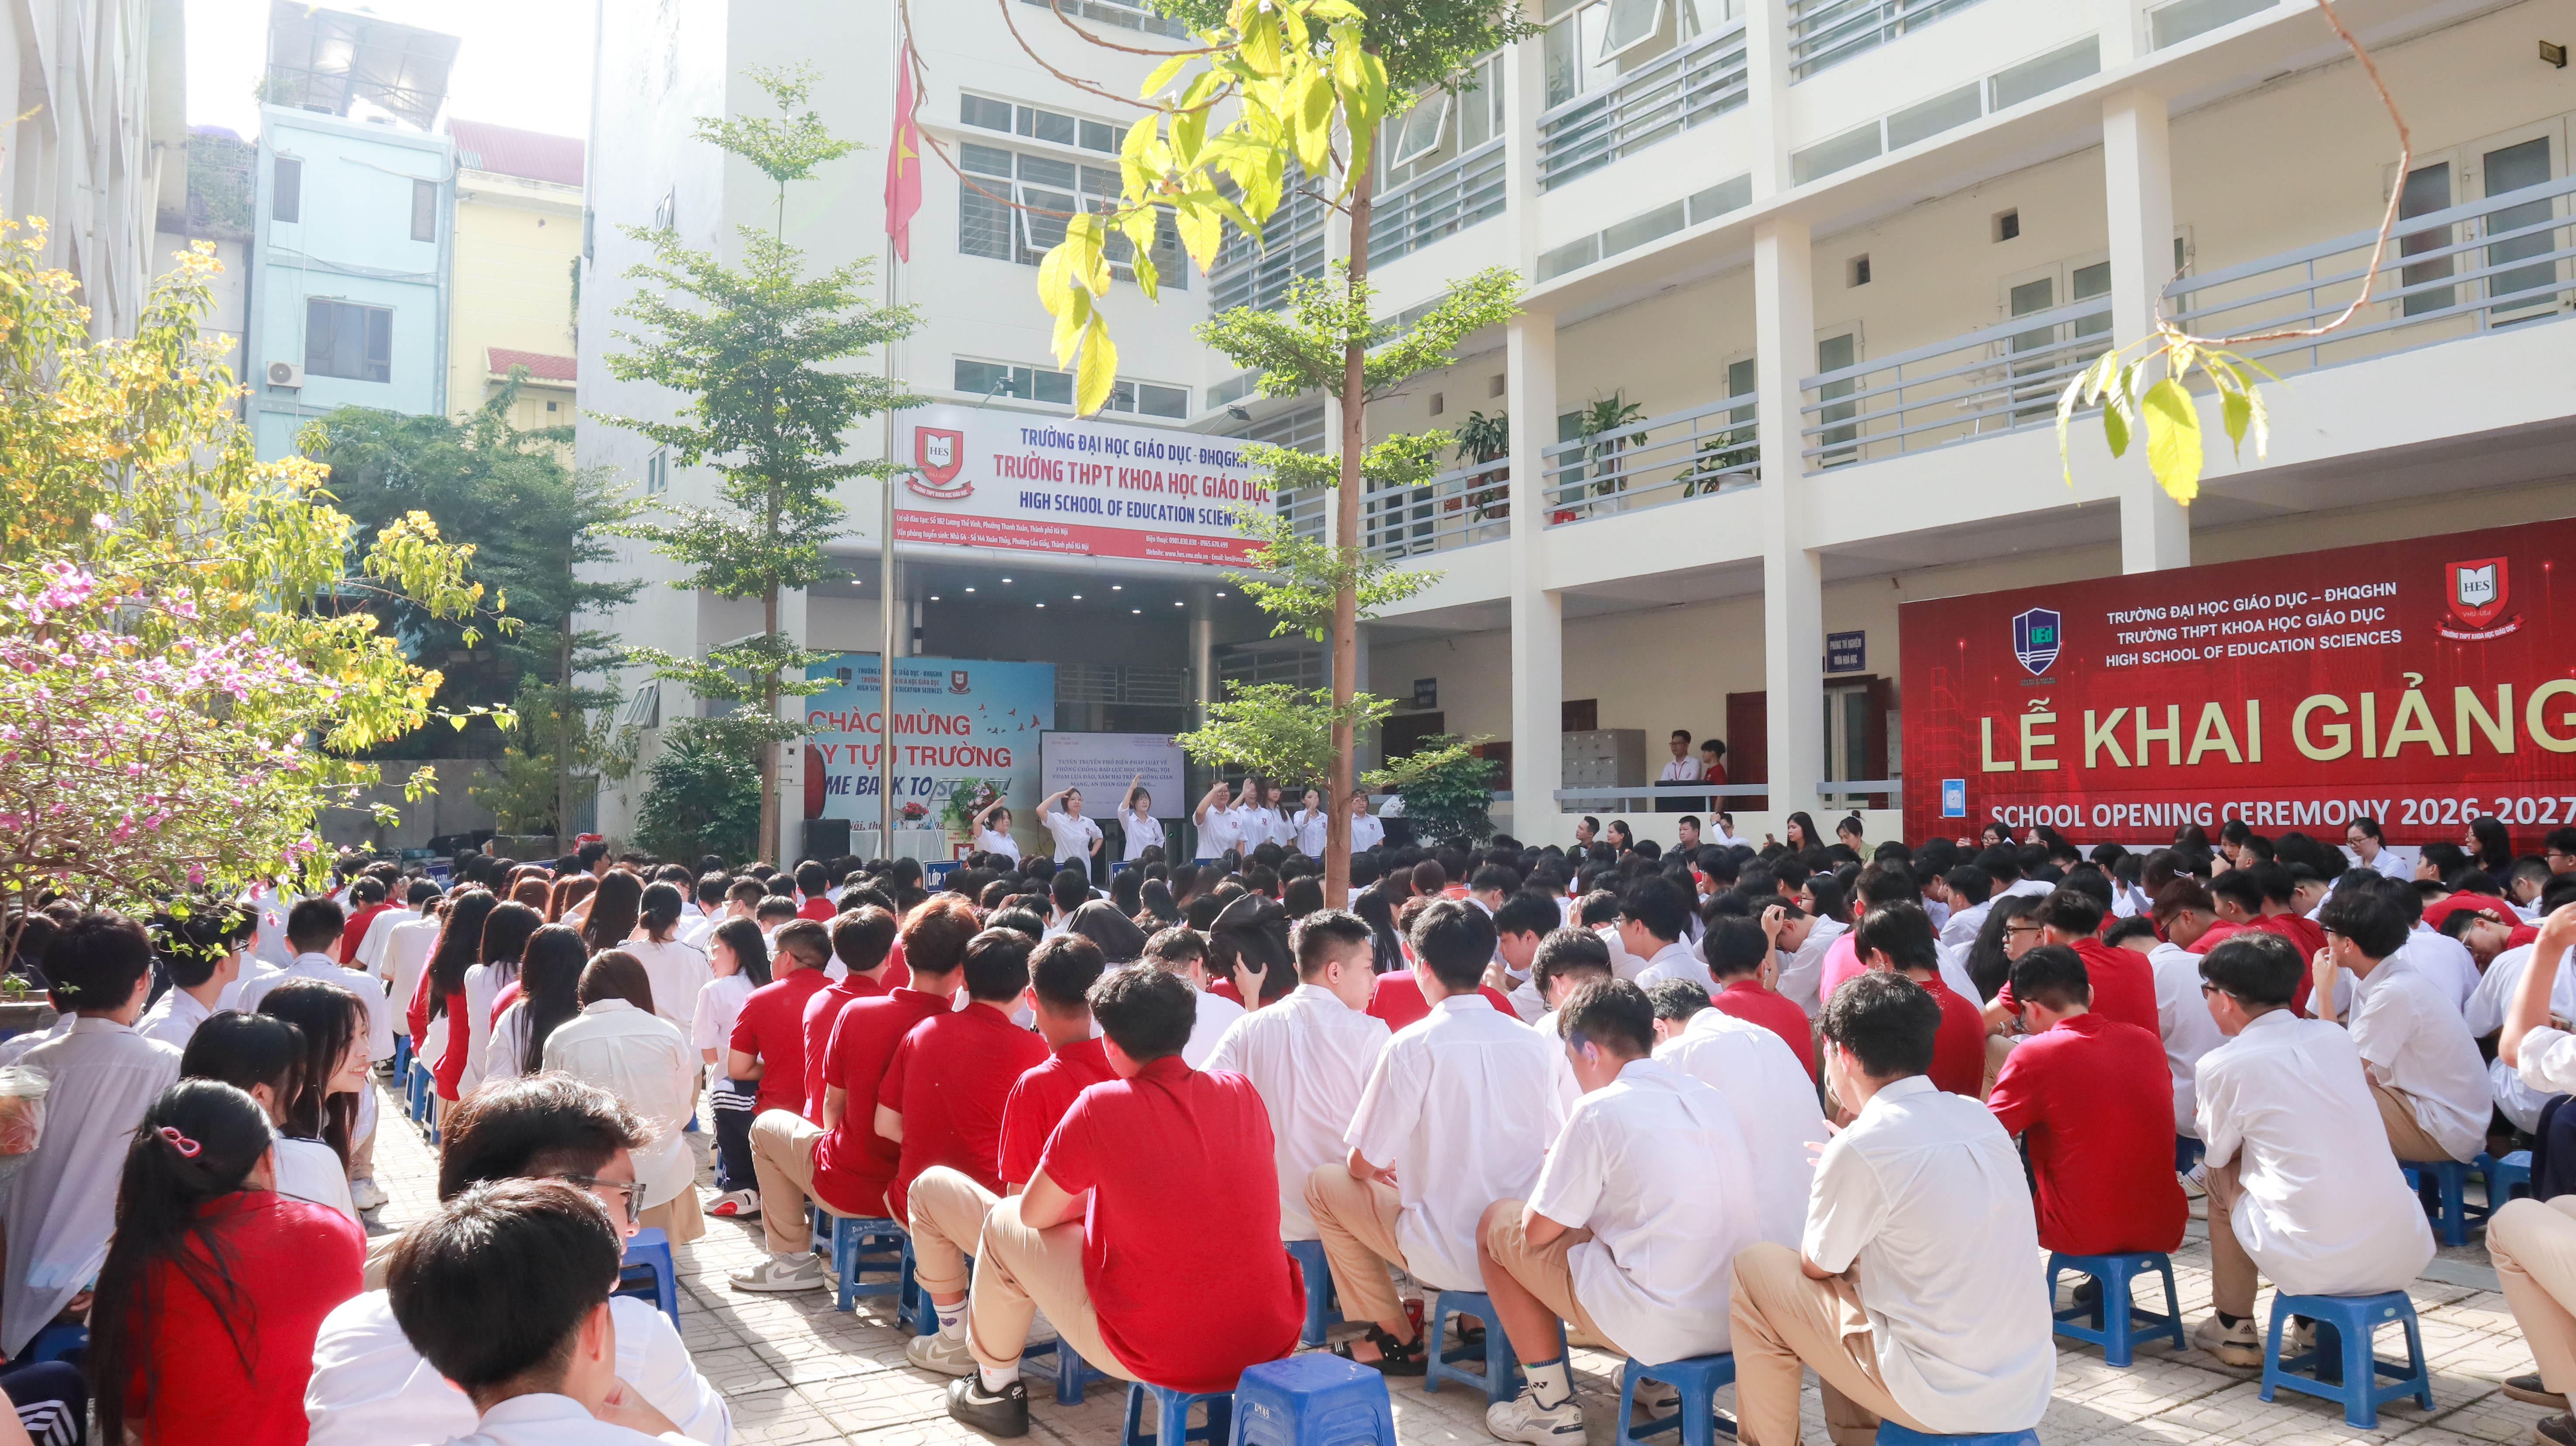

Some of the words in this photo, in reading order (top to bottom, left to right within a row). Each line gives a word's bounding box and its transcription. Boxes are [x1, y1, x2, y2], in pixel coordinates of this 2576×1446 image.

[929, 447, 949, 456] HES
[1021, 425, 1074, 449] TRƯỜNG
[1078, 435, 1101, 456] ĐẠI
[1105, 437, 1129, 459] HỌC
[1134, 438, 1164, 459] GIÁO
[1168, 445, 1191, 465] DỤC
[1199, 448, 1247, 468] ĐHQGHN
[994, 451, 1063, 481] TRƯỜNG
[1068, 462, 1113, 487] THPT
[1119, 467, 1164, 492] KHOA
[1168, 473, 1198, 500] HỌC
[1203, 473, 1238, 499] GIÁO
[912, 484, 926, 494] TRƯỜNG
[1020, 491, 1050, 510] HIGH
[1055, 494, 1103, 514] SCHOOL
[1108, 500, 1122, 516] OF
[1127, 501, 1195, 523] EDUCATION
[1199, 508, 1252, 528] SCIEN
[910, 515, 919, 523] đào
[930, 515, 936, 524] Số
[946, 518, 960, 527] Lương
[961, 518, 970, 527] Thế
[983, 521, 1000, 531] Phường
[1016, 525, 1029, 533] Xuân,
[1045, 525, 1053, 535] phố
[907, 529, 922, 538] phòng
[923, 529, 937, 539] tuyển
[970, 533, 977, 541] Số
[1012, 538, 1029, 547] Phường
[1066, 541, 1074, 550] phố
[1146, 535, 1156, 543] Điện
[1165, 551, 1208, 560] www.hes.vnu.edu.vn
[2464, 580, 2490, 592] HES
[2106, 607, 2166, 625] TRƯỜNG
[2170, 604, 2194, 620] ĐẠI
[2198, 600, 2229, 617] HỌC
[2233, 594, 2271, 611] GIÁO
[2275, 592, 2307, 608] DỤC
[2324, 582, 2396, 602] ĐHQGHN
[2117, 627, 2177, 645] TRƯỜNG
[2181, 624, 2218, 638] THPT
[2222, 619, 2265, 635] KHOA
[2268, 615, 2301, 632] HỌC
[2306, 609, 2346, 627] GIÁO
[2350, 607, 2386, 625] DỤC
[2441, 629, 2459, 638] TRƯỜNG
[2495, 627, 2506, 636] GIÁO
[2506, 624, 2516, 633] DỤC
[2106, 652, 2138, 667] HIGH
[2142, 648, 2201, 664] SCHOOL
[2204, 645, 2223, 659] OF
[2228, 637, 2315, 657] EDUCATION
[2319, 629, 2402, 649] SCIENCES
[894, 708, 970, 735] MỪNG
[1981, 697, 2058, 772] LỄ
[2084, 699, 2261, 769] KHAI
[2292, 672, 2576, 761] GIẢNG
[905, 741, 1011, 767] TRƯỜNG
[855, 776, 905, 796] BAK
[911, 776, 932, 796] TO
[1991, 804, 2086, 828] SCHOOL
[2092, 802, 2213, 827] OPENING
[2221, 799, 2391, 826] CEREMONY
[2400, 796, 2576, 826] 2026-2027
[928, 868, 941, 886] LỚP
